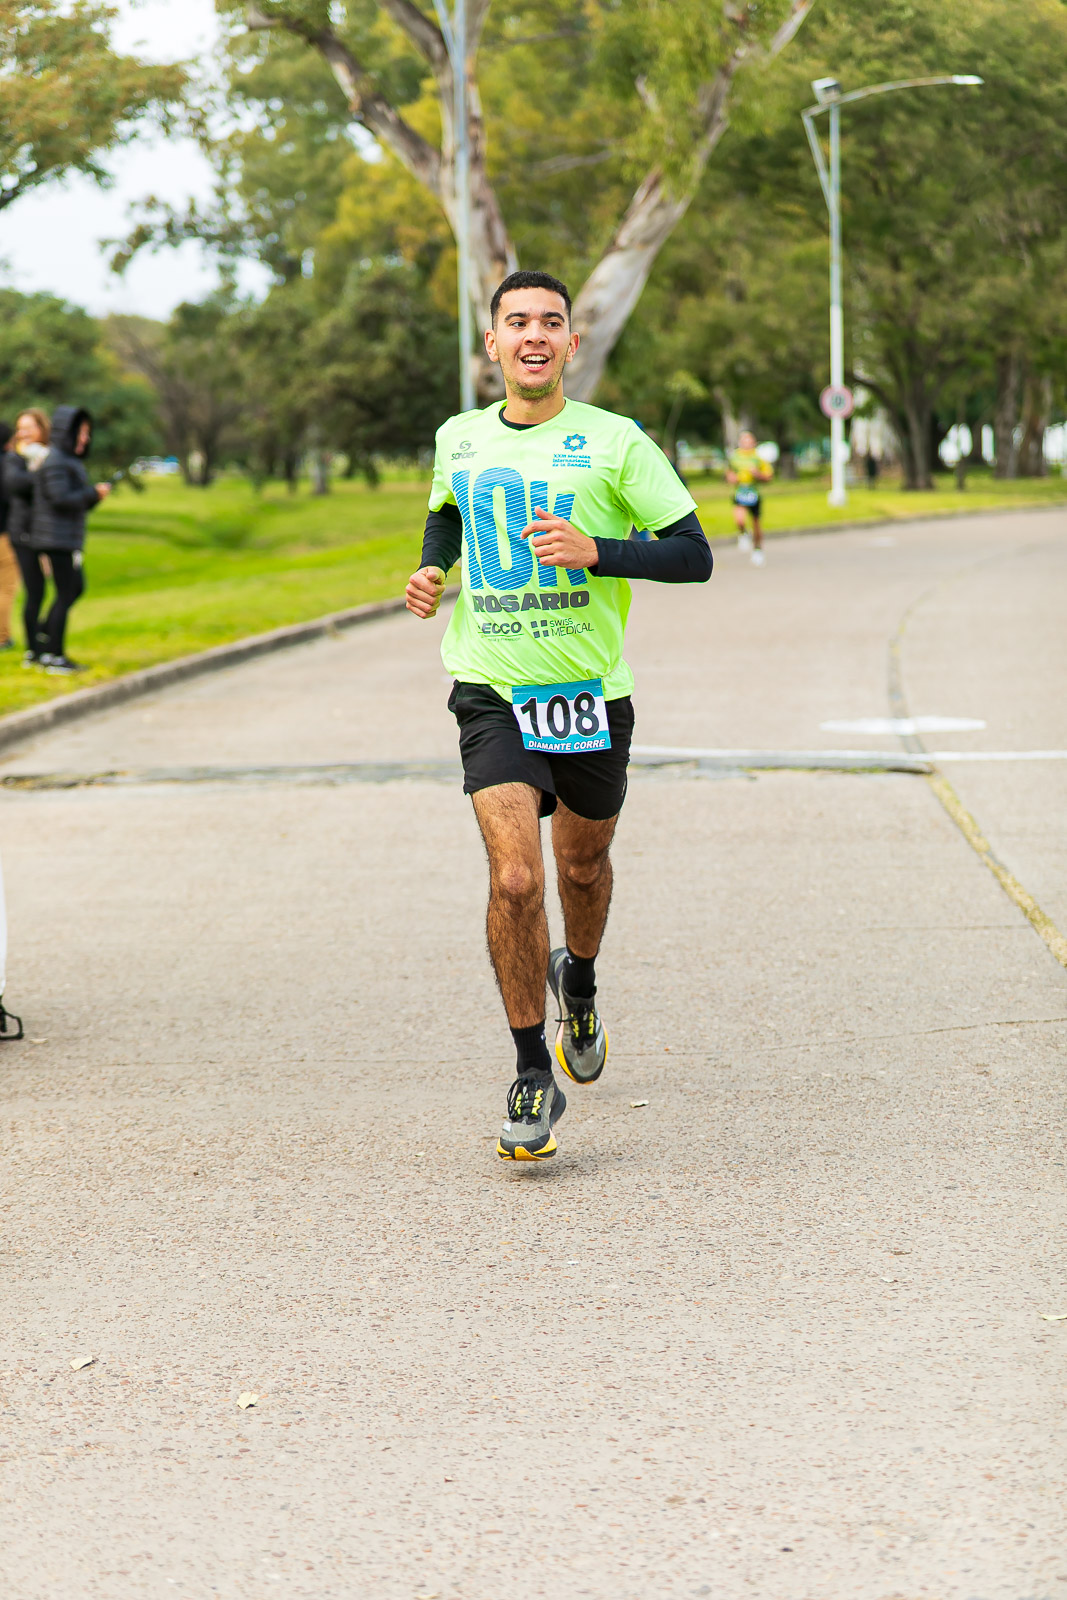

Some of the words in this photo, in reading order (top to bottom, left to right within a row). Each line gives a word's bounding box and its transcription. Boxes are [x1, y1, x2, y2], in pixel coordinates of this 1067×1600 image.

[472, 590, 590, 612] ROSARIO
[549, 618, 573, 627] SWISS
[550, 622, 594, 637] MEDICAL
[520, 691, 599, 739] 108
[528, 740, 571, 750] DIAMANTE
[574, 739, 605, 750] CORRE
